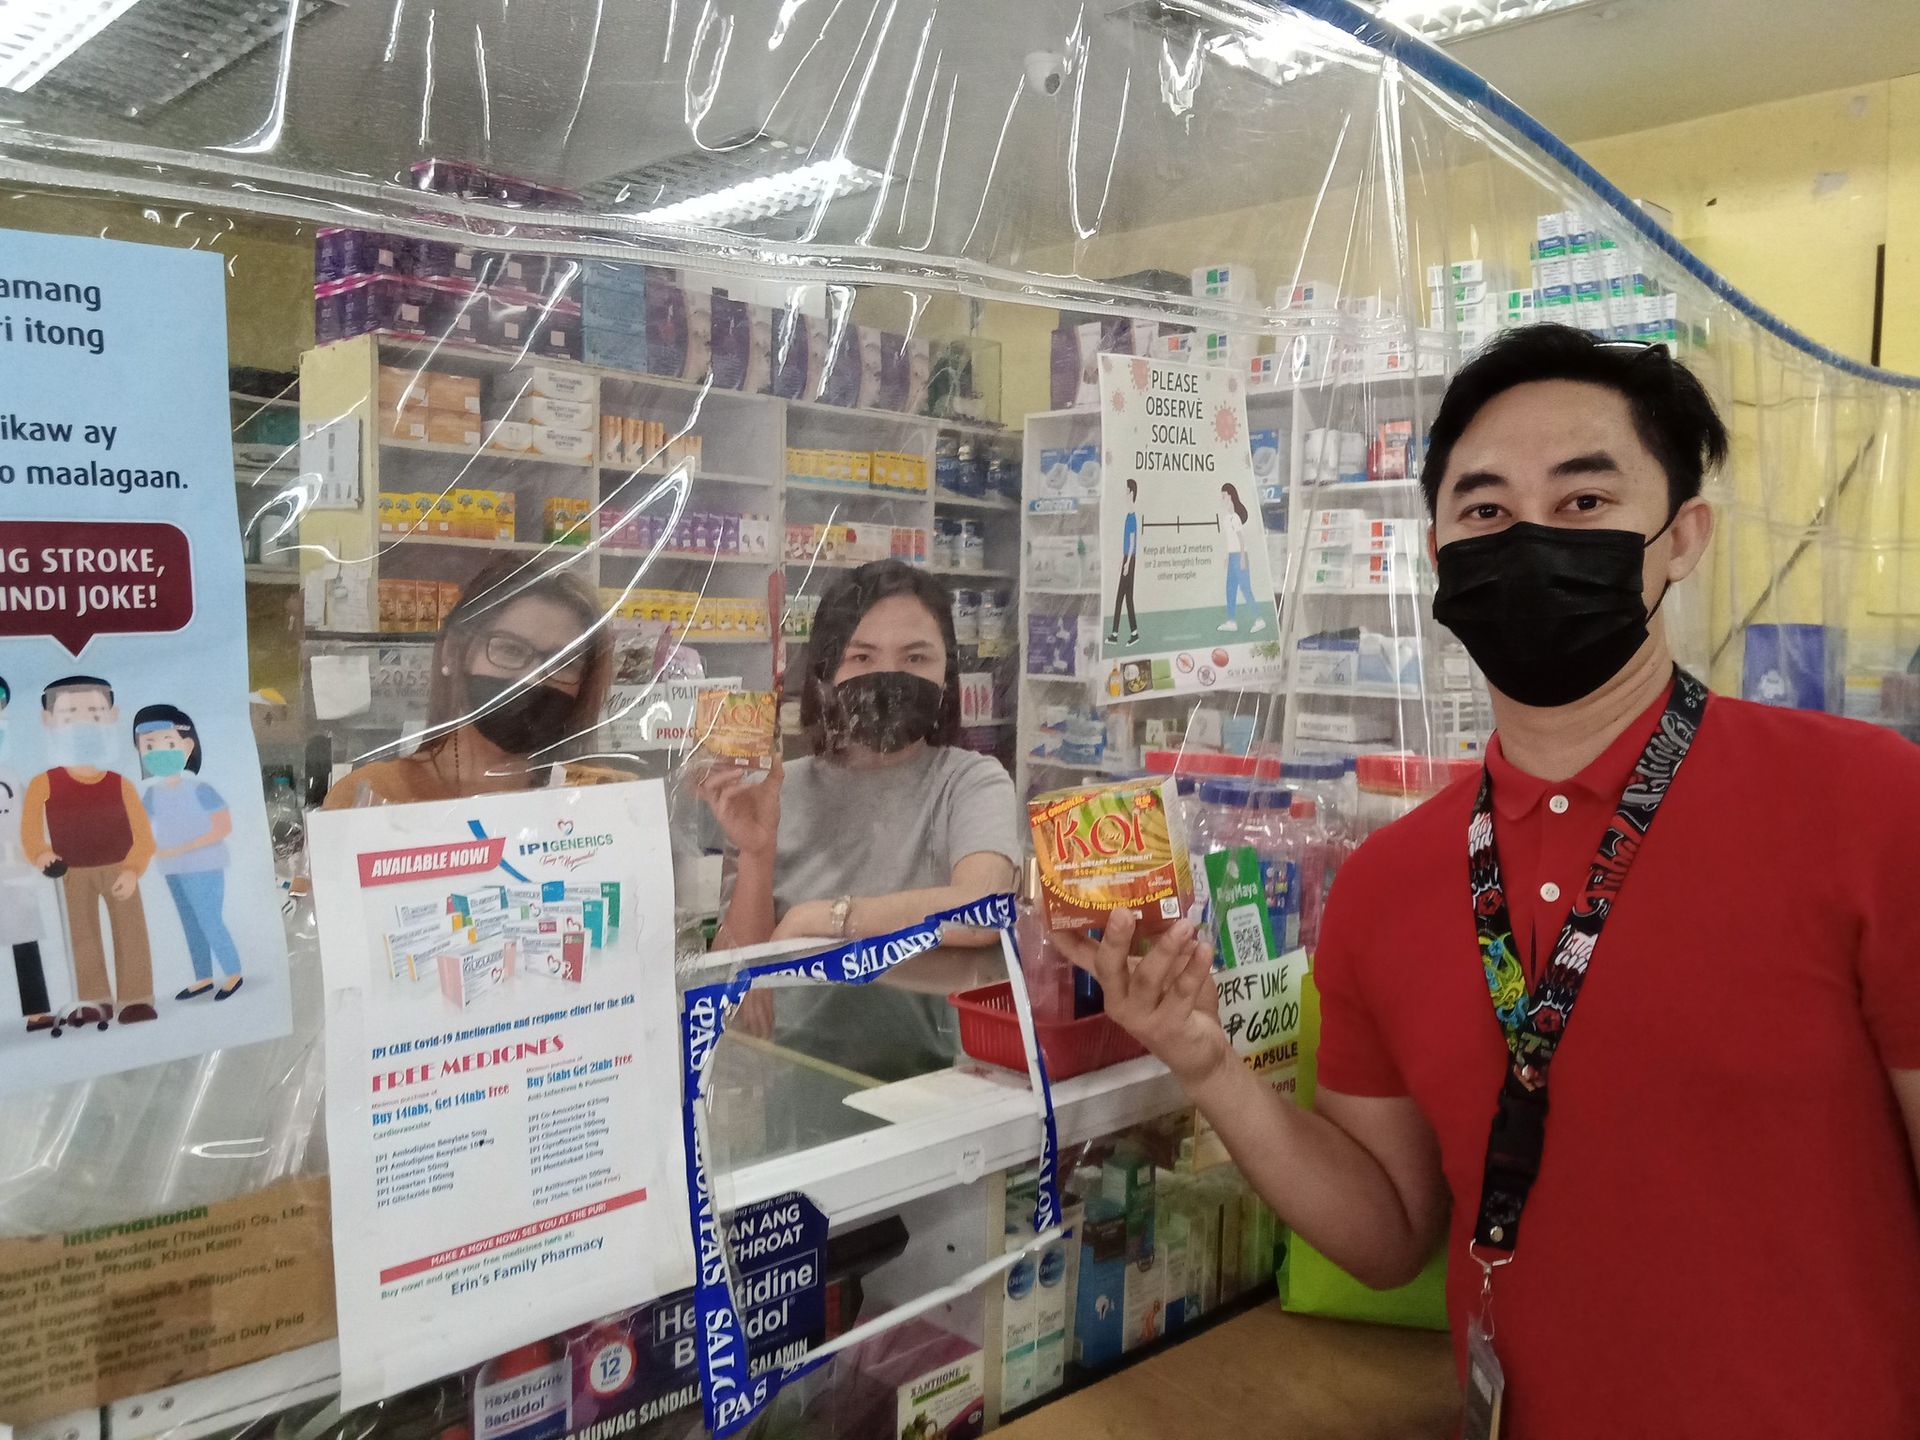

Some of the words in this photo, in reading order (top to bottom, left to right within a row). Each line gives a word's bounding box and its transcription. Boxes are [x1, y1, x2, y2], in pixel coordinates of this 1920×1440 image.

[25, 316, 105, 354] itong
[1152, 369, 1199, 394] PLEASE
[1145, 396, 1204, 420] OBSERVE
[1, 415, 72, 443] ikaw
[84, 423, 117, 450] ay
[1152, 425, 1196, 446] SOCIAL
[27, 461, 189, 494] maalagaan.
[1135, 450, 1215, 472] DISTANCING
[41, 548, 166, 578] STROKE,
[1144, 546, 1158, 556] Keep
[1166, 545, 1181, 554] least
[1182, 544, 1187, 553] 2
[1188, 544, 1213, 553] meters
[1196, 557, 1212, 566] from
[1157, 571, 1173, 580] other
[1174, 571, 1196, 582] people
[77, 585, 158, 618] JOKE!
[1055, 808, 1146, 863] KOI
[371, 850, 447, 878] AVAILABLE
[449, 846, 490, 869] NOW!
[1040, 874, 1051, 887] NO
[1050, 886, 1090, 910] APPROVED
[1092, 896, 1145, 911] THERAPEUTIC
[1145, 887, 1174, 904] CLAIMS
[1217, 965, 1289, 1007] PERFUME
[372, 1047, 387, 1060] IPI
[389, 1041, 412, 1056] CARE
[414, 1033, 453, 1050] Covid-19
[455, 1020, 512, 1042] Amelioration
[514, 1017, 530, 1029] and
[532, 1009, 568, 1026] response
[569, 1003, 591, 1016] effort
[593, 1000, 605, 1012] for
[607, 997, 619, 1009] the
[621, 993, 635, 1007] sick
[372, 1063, 436, 1093] FREE
[440, 1034, 564, 1078] MEDICINES
[527, 1076, 545, 1089] Buy
[573, 1064, 588, 1076] Get
[590, 1059, 613, 1073] 2tabs
[614, 1054, 633, 1067] Free
[372, 1113, 392, 1126] Buy
[396, 1103, 432, 1121] 14tabs,
[435, 1098, 452, 1111] Get
[455, 1089, 486, 1106] 14tabs
[488, 1084, 510, 1098] Free
[173, 1219, 246, 1247] (Thailand)
[759, 1204, 800, 1235] ANG
[431, 1252, 457, 1267] MAKE
[459, 1249, 467, 1260] A
[468, 1240, 495, 1257] MOVE
[496, 1233, 521, 1250] NOW,
[521, 1226, 538, 1239] SEE
[538, 1220, 557, 1233] YOU
[558, 1215, 570, 1227] AT
[570, 1210, 586, 1222] THE
[733, 1223, 804, 1263] THROAT
[381, 1287, 399, 1300] Buy
[426, 1271, 443, 1286] and
[445, 1267, 460, 1281] get
[461, 1261, 480, 1275] your
[482, 1255, 501, 1268] free
[502, 1242, 543, 1262] medicines
[493, 1258, 538, 1282] Family
[541, 1235, 605, 1266] Pharmacy
[240, 1323, 272, 1341] Duty
[275, 1312, 305, 1330] Paid
[600, 1356, 621, 1379] 12
[749, 1337, 808, 1381] SALAMIN
[580, 1408, 637, 1440] HUWAG
